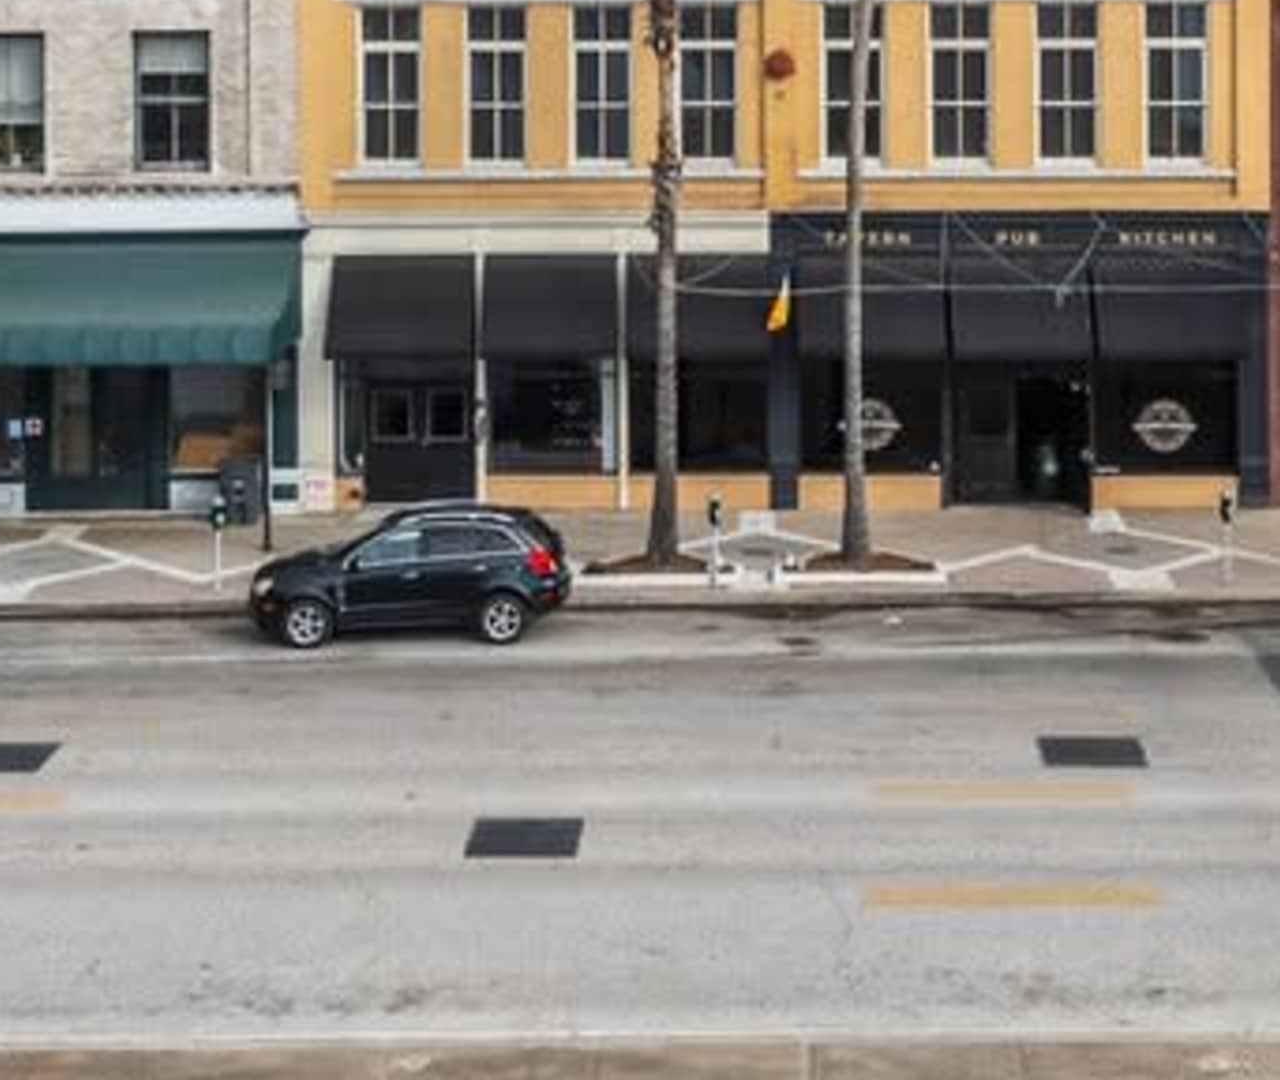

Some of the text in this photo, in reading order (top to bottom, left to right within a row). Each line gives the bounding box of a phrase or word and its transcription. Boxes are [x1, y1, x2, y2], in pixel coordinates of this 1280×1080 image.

[825, 231, 912, 246] TAERN
[996, 231, 1040, 246] PUB
[1119, 231, 1217, 246] KITCHEN
